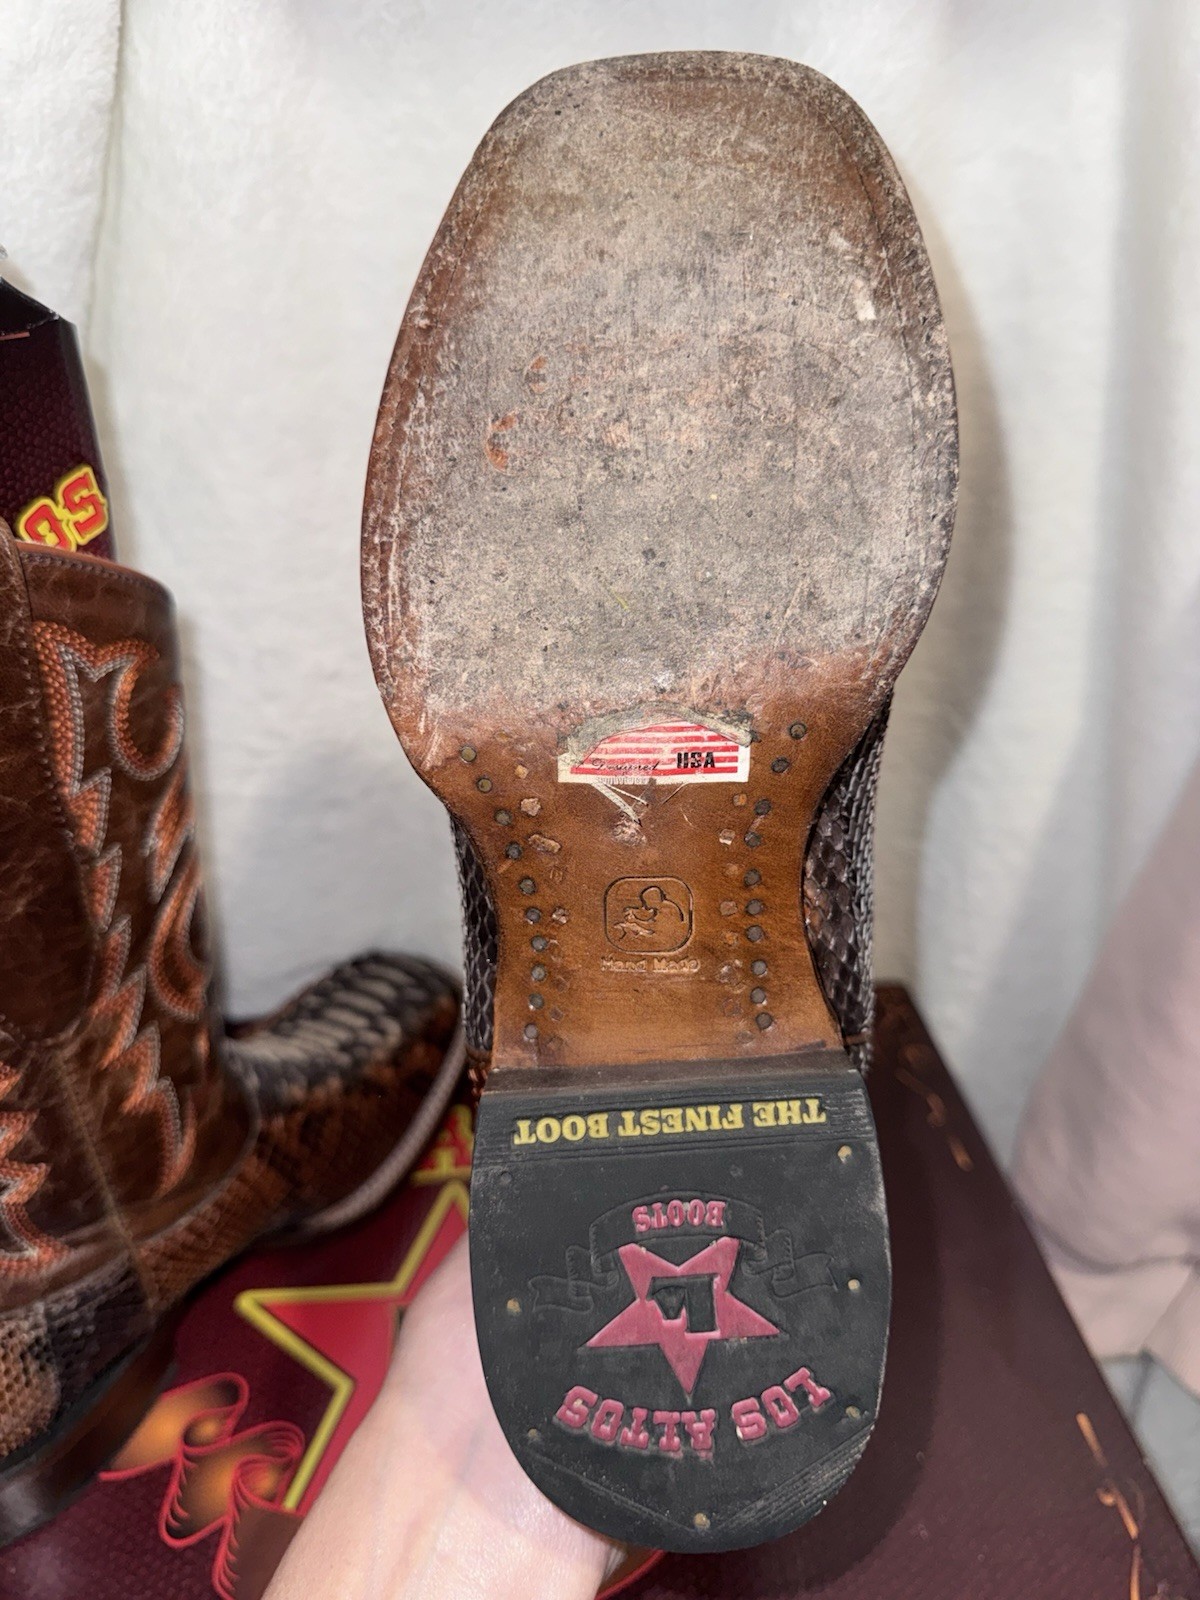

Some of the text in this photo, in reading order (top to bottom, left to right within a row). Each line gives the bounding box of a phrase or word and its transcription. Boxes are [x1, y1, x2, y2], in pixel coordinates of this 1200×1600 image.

[676, 751, 716, 768] USA
[513, 1112, 609, 1145] BOOT
[617, 1103, 744, 1137] FINEST
[752, 1098, 826, 1127] THE
[632, 1199, 726, 1232] BOOTS
[555, 1366, 831, 1455] LOS ALTOS
